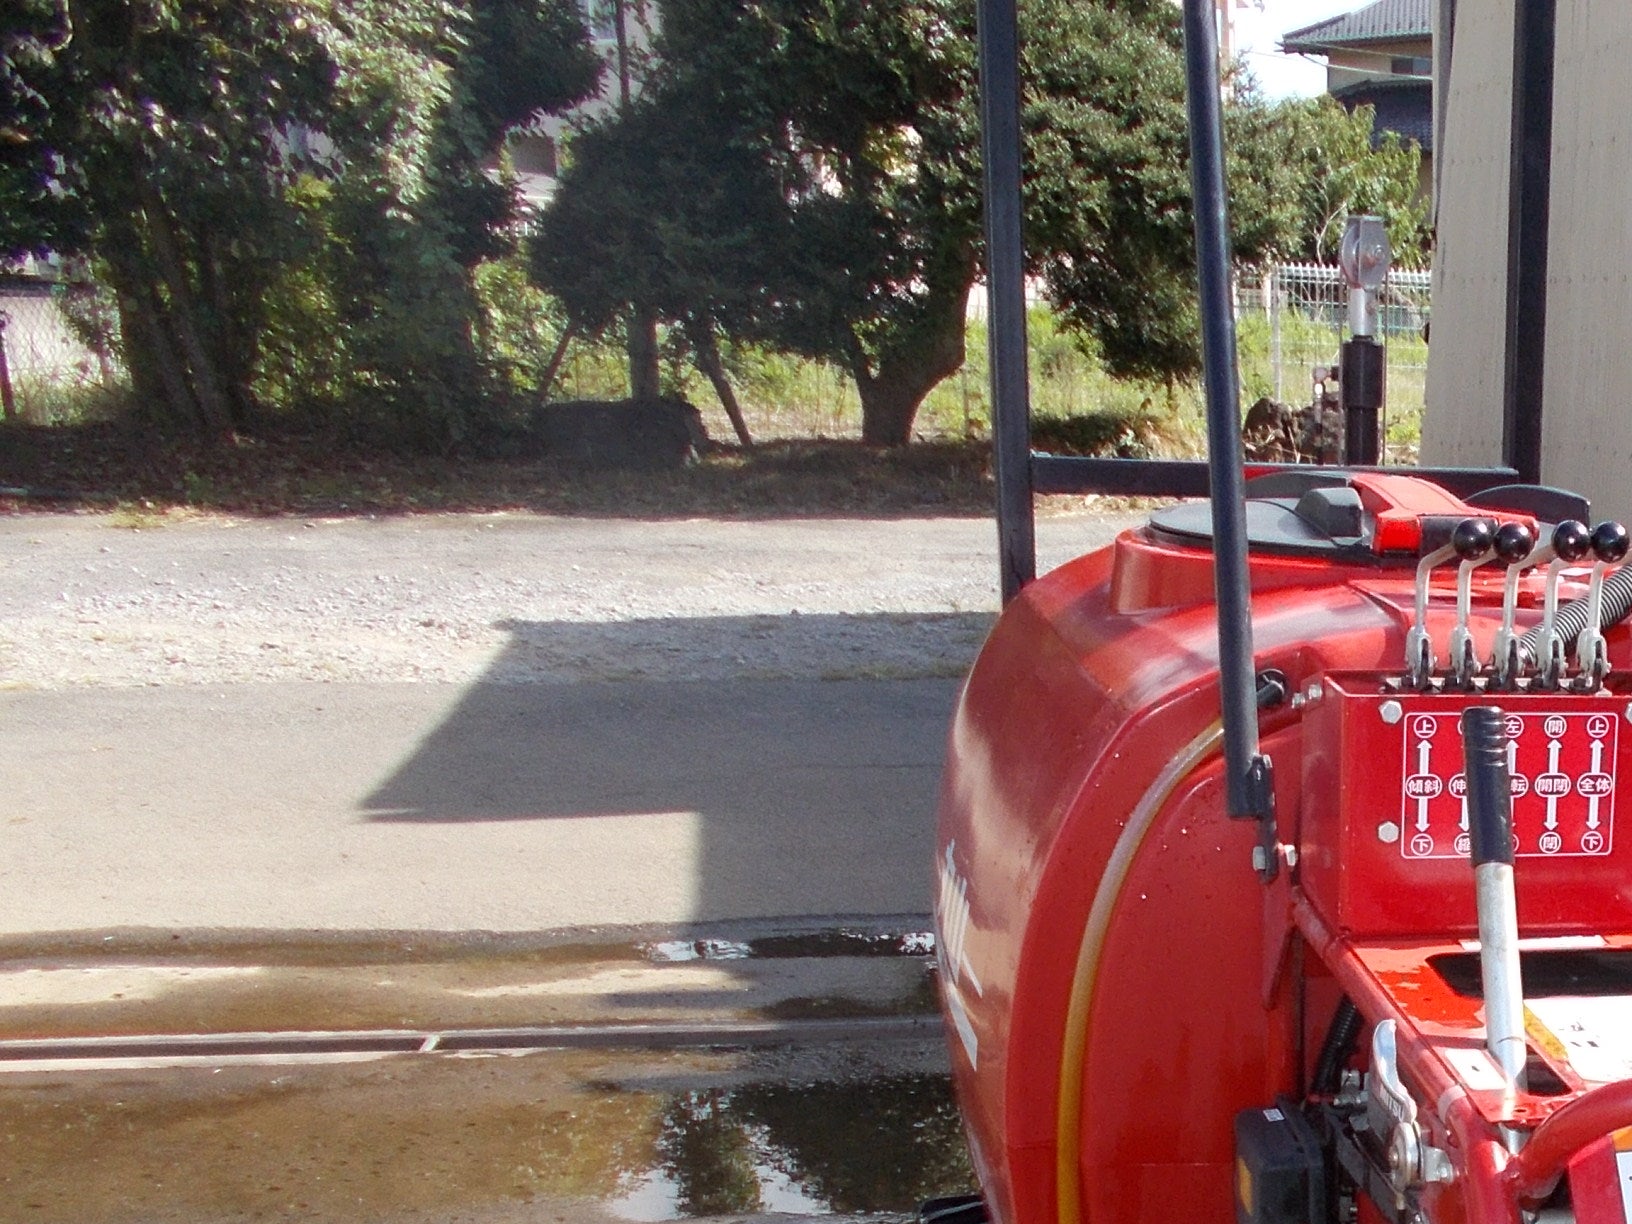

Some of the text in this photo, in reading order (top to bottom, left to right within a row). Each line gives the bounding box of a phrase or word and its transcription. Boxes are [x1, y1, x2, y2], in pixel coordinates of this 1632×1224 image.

[1417, 719, 1433, 736] 上
[1548, 719, 1563, 734] 開
[1590, 719, 1606, 735] 上
[1408, 777, 1441, 794] 傾斜
[1537, 777, 1569, 793] 開閉
[1579, 777, 1611, 793] 全体
[1415, 838, 1430, 852] 下
[1543, 836, 1558, 850] 閉
[1585, 836, 1600, 850] 下
